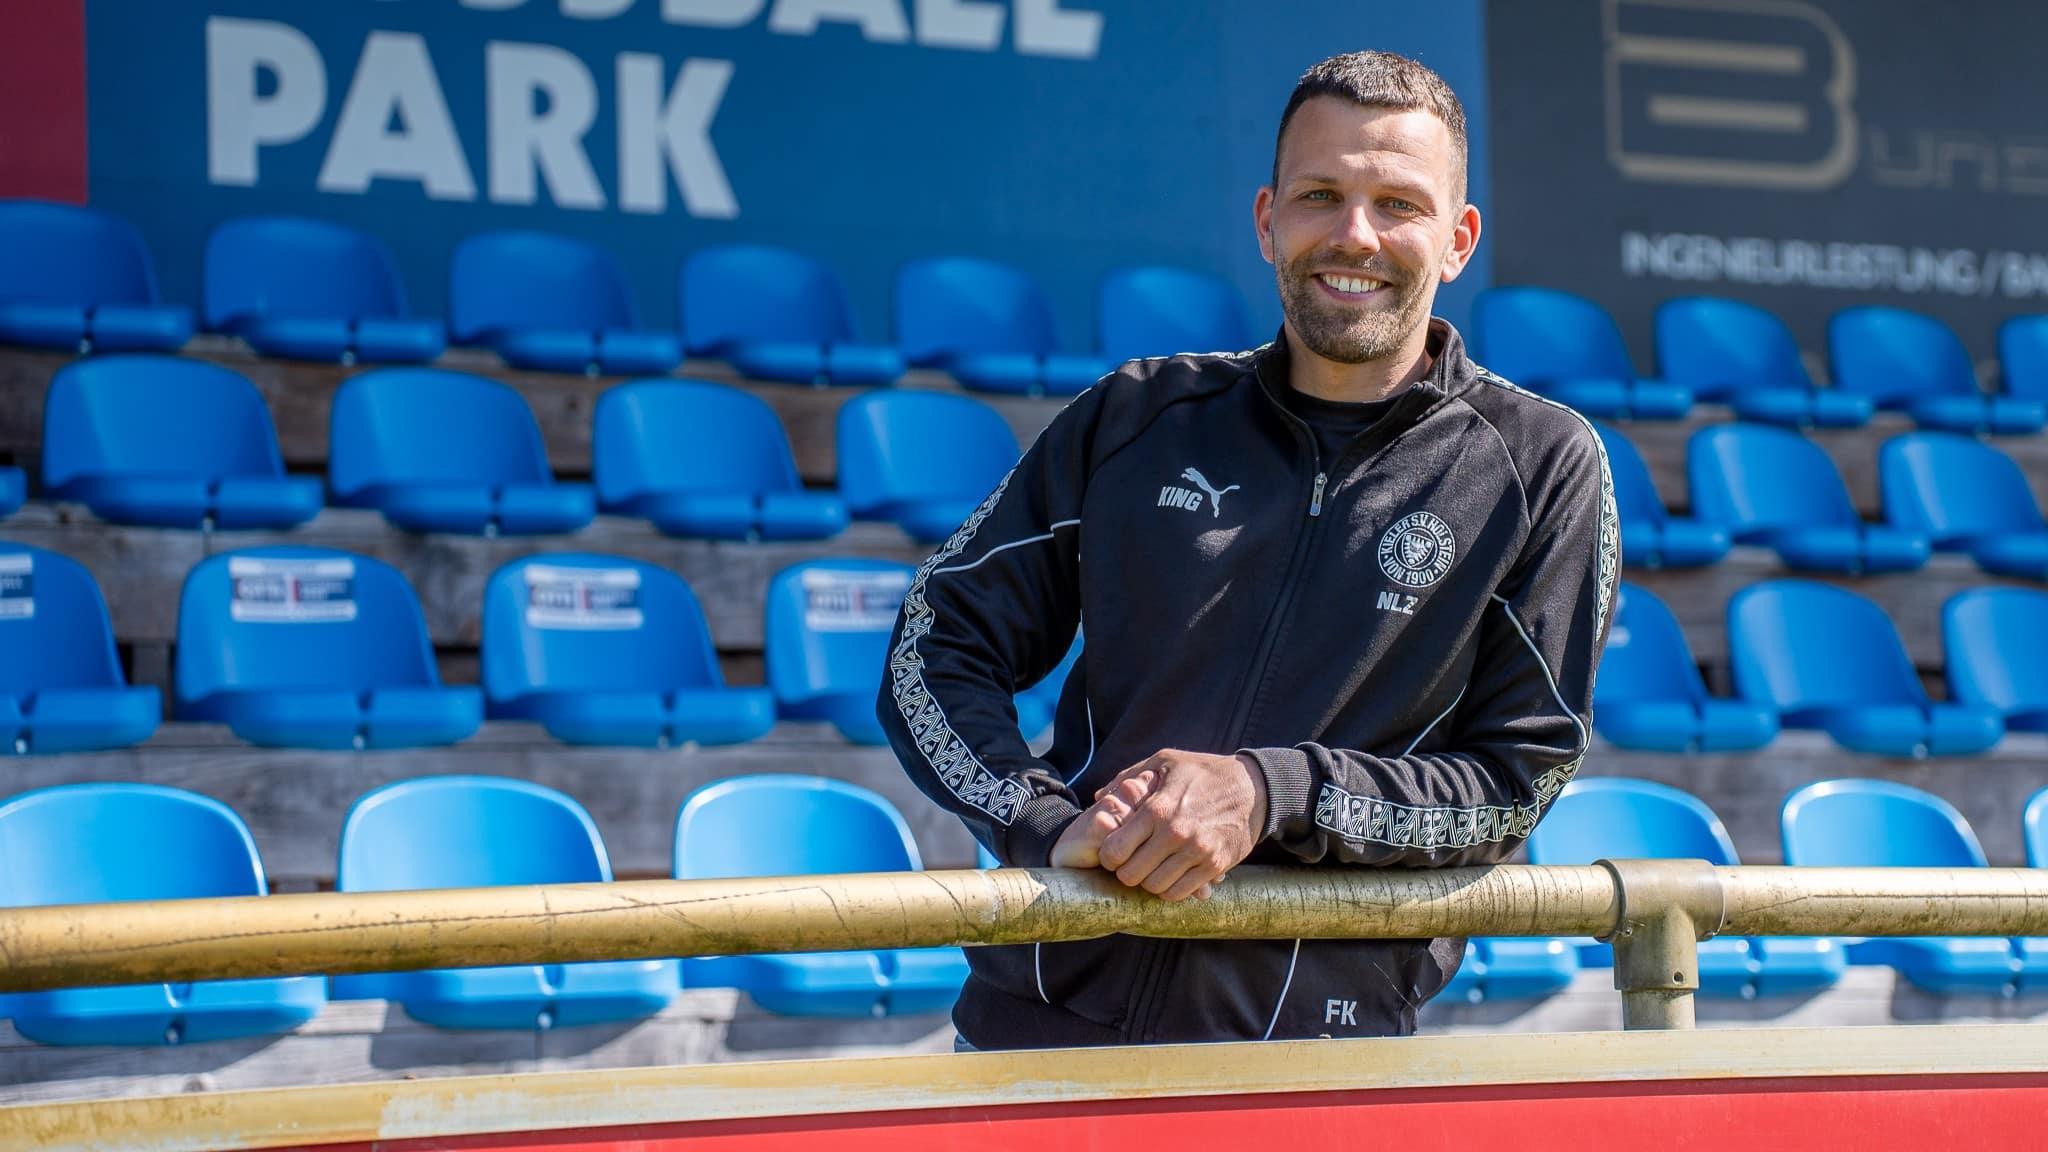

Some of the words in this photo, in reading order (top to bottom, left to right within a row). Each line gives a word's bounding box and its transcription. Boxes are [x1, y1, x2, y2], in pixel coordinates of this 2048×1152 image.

[206, 16, 740, 218] PARK
[1157, 486, 1203, 512] KING
[1381, 519, 1411, 555] KIELER
[1427, 518, 1453, 573] HOLSTEIN
[1383, 556, 1406, 580] VON
[1405, 568, 1434, 584] 1900
[1376, 591, 1419, 615] NLZ
[1325, 999, 1357, 1026] FK
